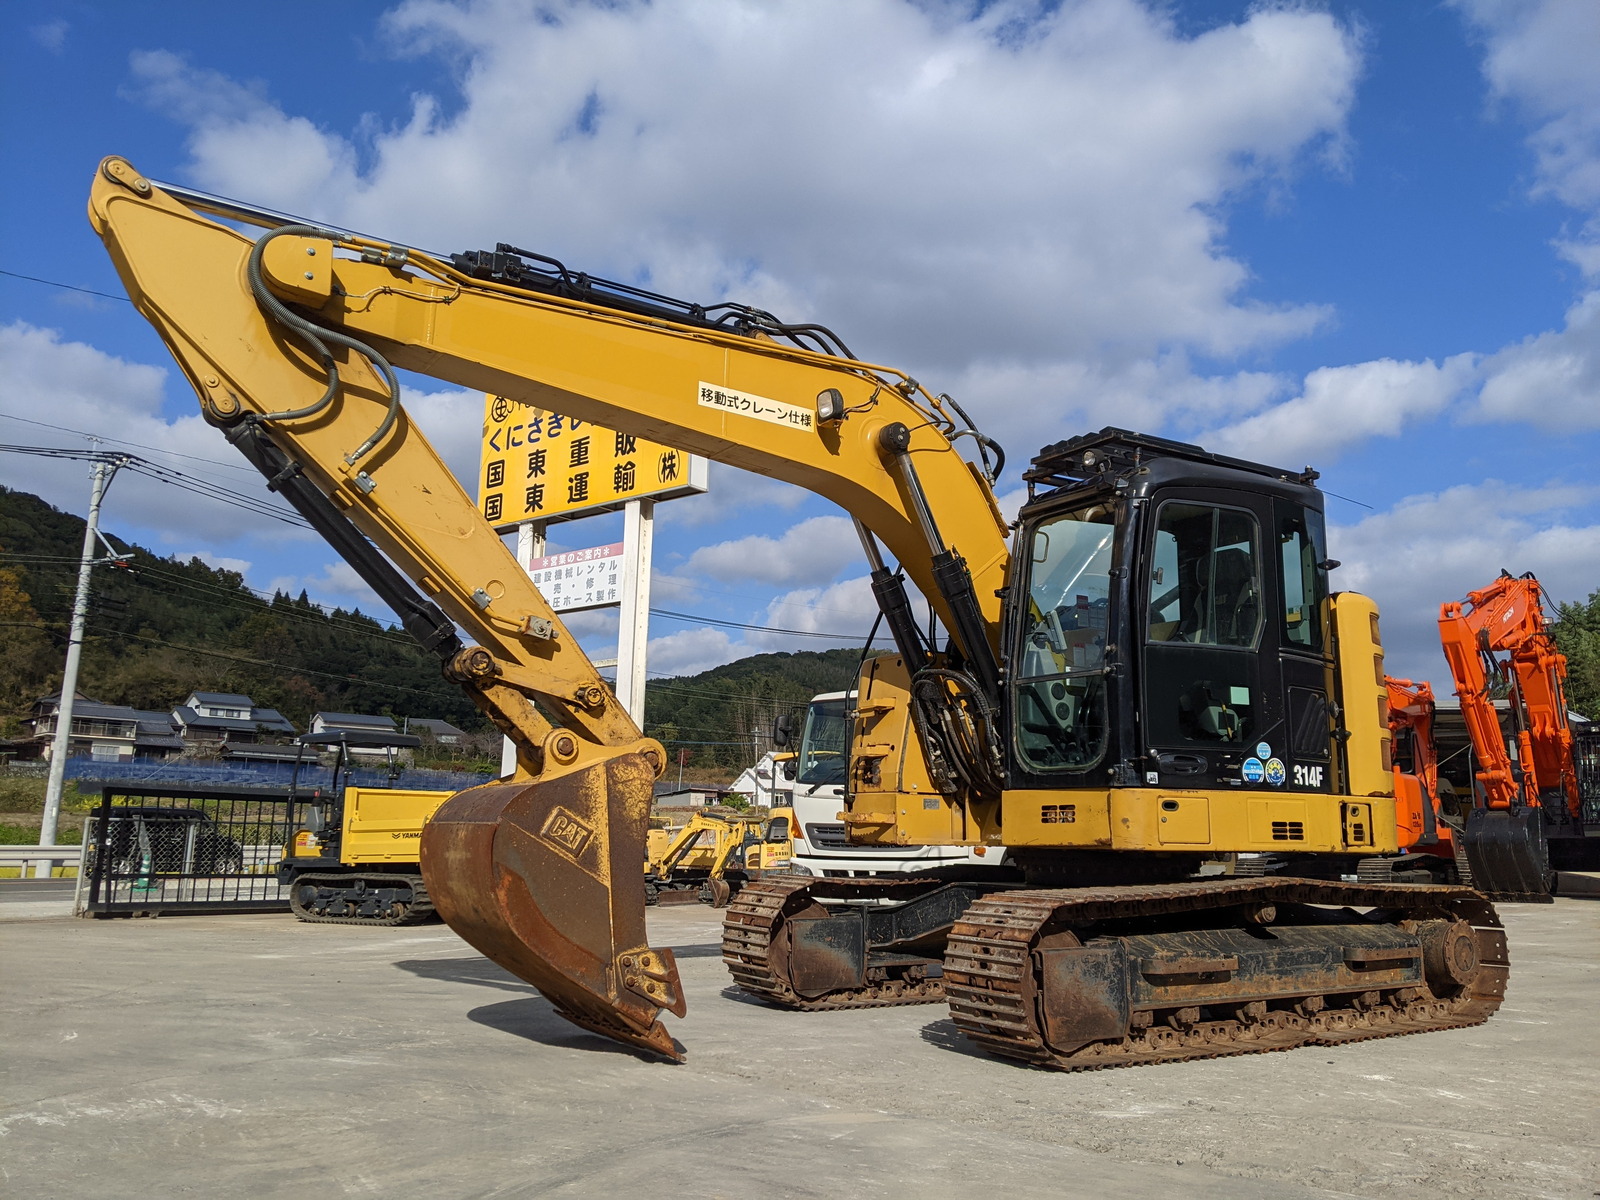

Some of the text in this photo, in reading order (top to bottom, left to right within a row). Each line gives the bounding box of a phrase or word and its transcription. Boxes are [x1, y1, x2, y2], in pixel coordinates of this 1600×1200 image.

[701, 387, 812, 427] 移動式クレーン仕様
[534, 560, 618, 584] 建設機械レンタル
[547, 588, 617, 608] 圧ホース製作
[1293, 764, 1324, 788] 314F
[548, 815, 588, 850] CAT
